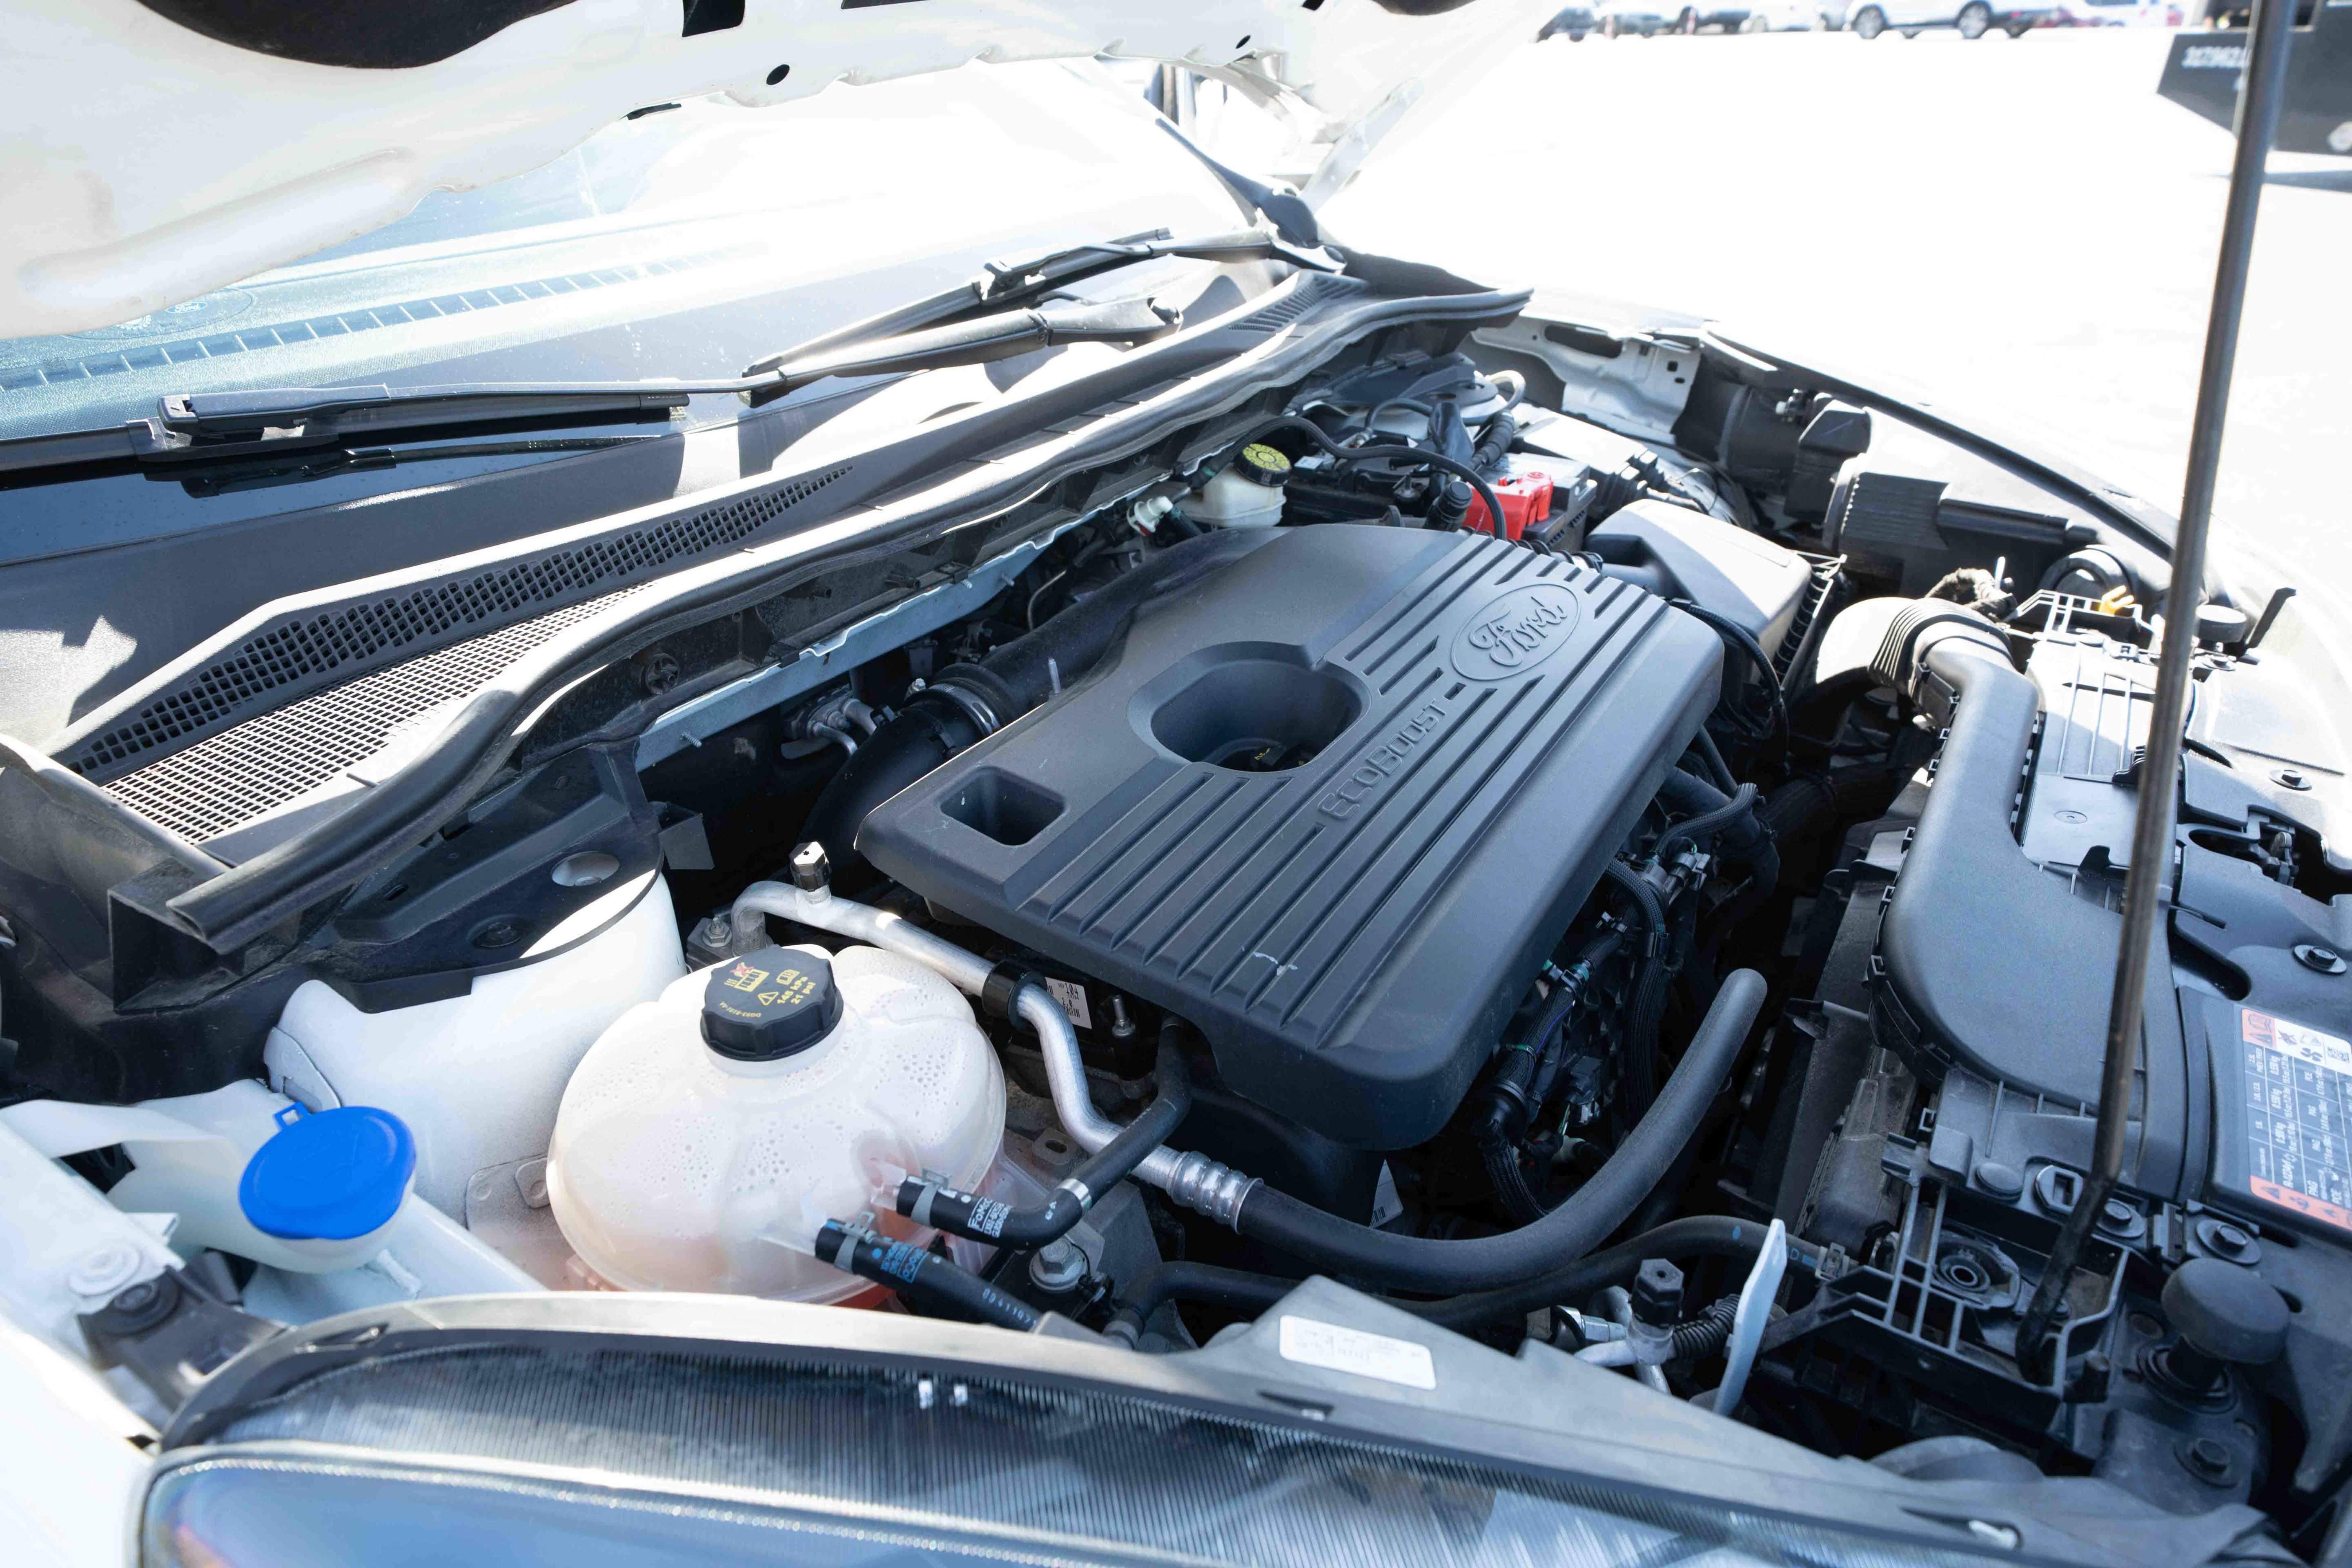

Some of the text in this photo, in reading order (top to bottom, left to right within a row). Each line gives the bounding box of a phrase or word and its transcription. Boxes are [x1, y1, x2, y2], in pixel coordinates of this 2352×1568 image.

[174, 302, 200, 313] Ford
[1466, 596, 1570, 667] Ford
[1318, 698, 1449, 821] ECOBOOST
[777, 976, 808, 1004] 145 kPa
[791, 982, 816, 1004] 21 psi
[1061, 997, 1073, 1007] 2.0
